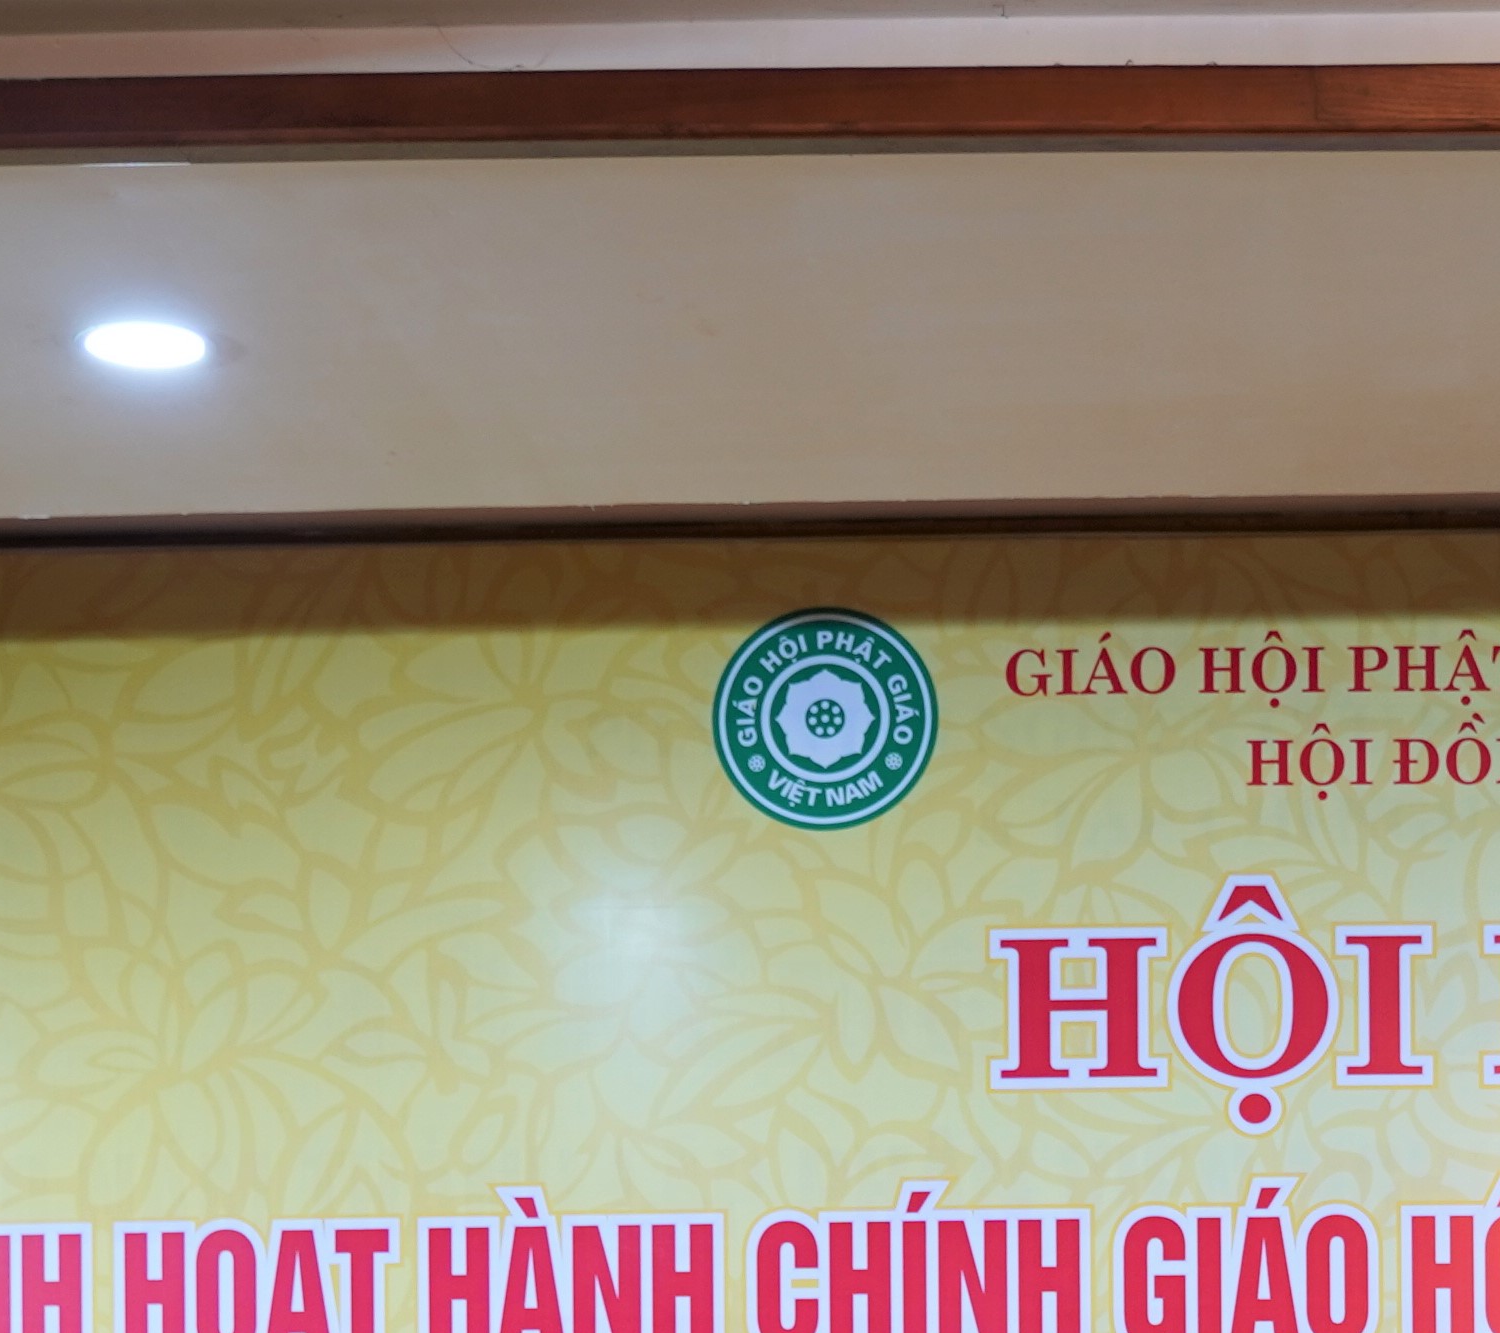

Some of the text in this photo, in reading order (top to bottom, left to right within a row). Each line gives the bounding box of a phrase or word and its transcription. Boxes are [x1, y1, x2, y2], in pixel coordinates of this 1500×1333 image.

[731, 630, 919, 747] GIÁO HỘI PHẬT GIÁO
[1006, 633, 1177, 698] GIÁO
[1202, 631, 1323, 708] HỘI
[768, 769, 884, 807] VIỆT NAM
[1250, 723, 1369, 801] HỘI
[1000, 886, 1425, 1125] HỘI
